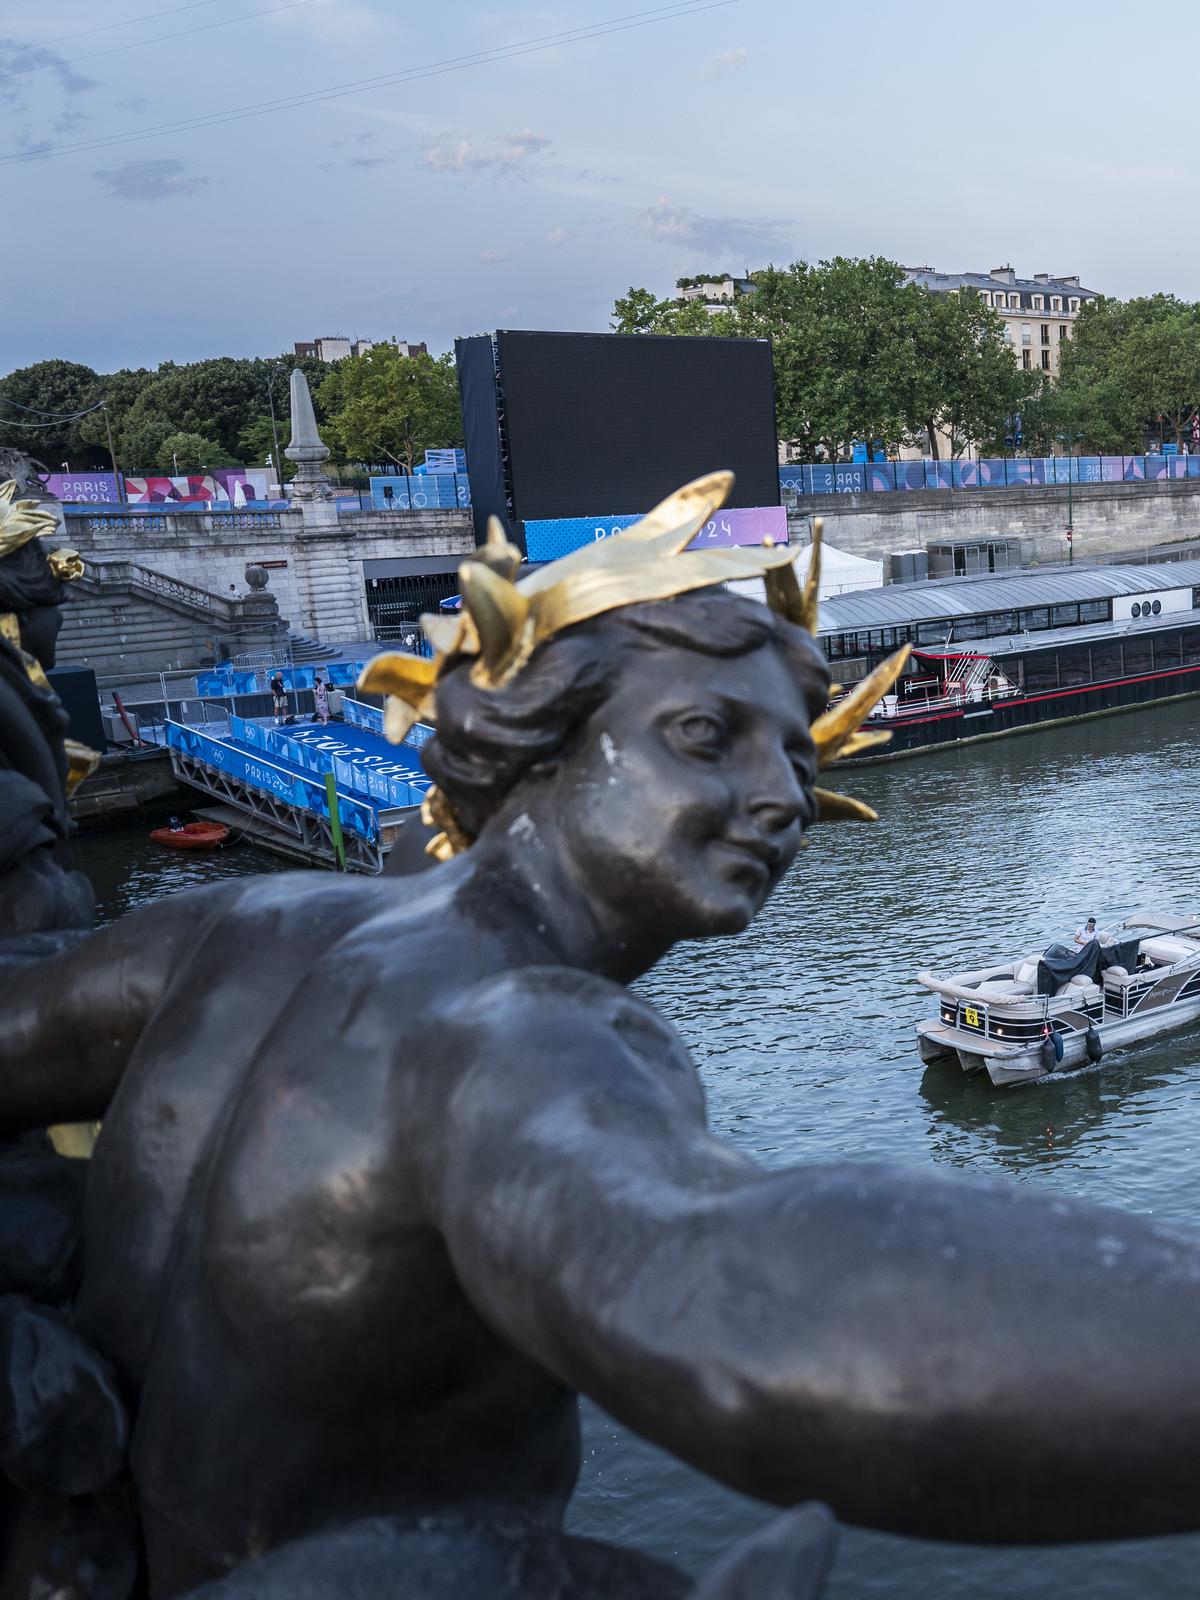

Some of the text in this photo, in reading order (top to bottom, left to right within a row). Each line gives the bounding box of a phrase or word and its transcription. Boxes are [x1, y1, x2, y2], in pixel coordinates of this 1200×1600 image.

[63, 481, 108, 493] PARIS
[292, 730, 366, 756] 2024
[244, 762, 272, 784] PARIS
[352, 755, 434, 787] PARIS
[969, 1014, 975, 1024] 9
